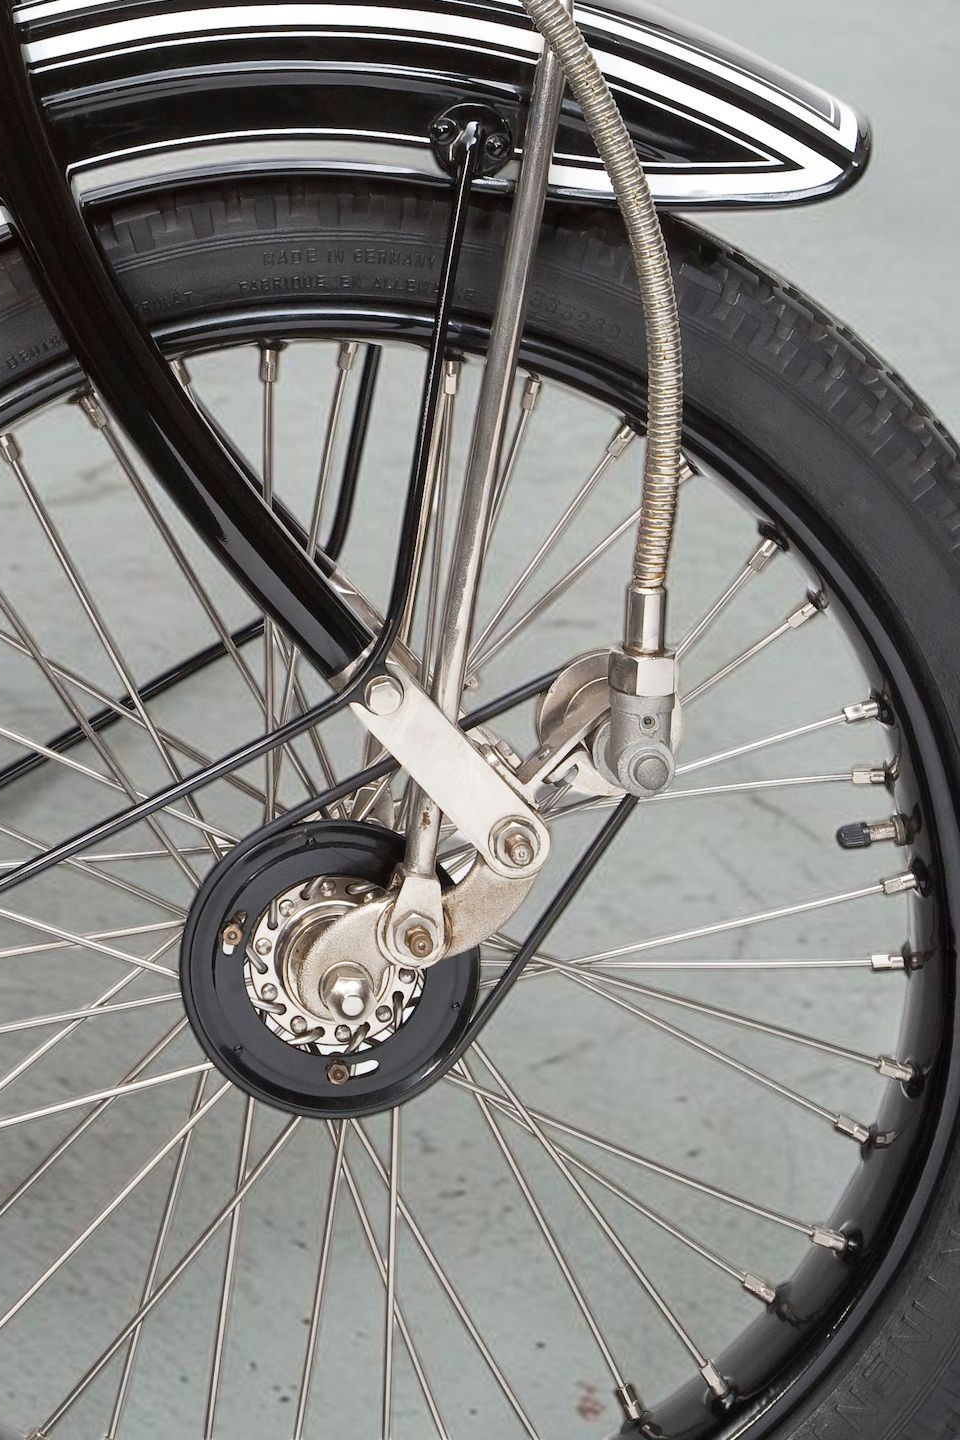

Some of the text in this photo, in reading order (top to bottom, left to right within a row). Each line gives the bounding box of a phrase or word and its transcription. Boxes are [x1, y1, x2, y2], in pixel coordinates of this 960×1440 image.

[262, 247, 437, 269] MADE IN GERMANY
[372, 275, 476, 300] ALLEMANE
